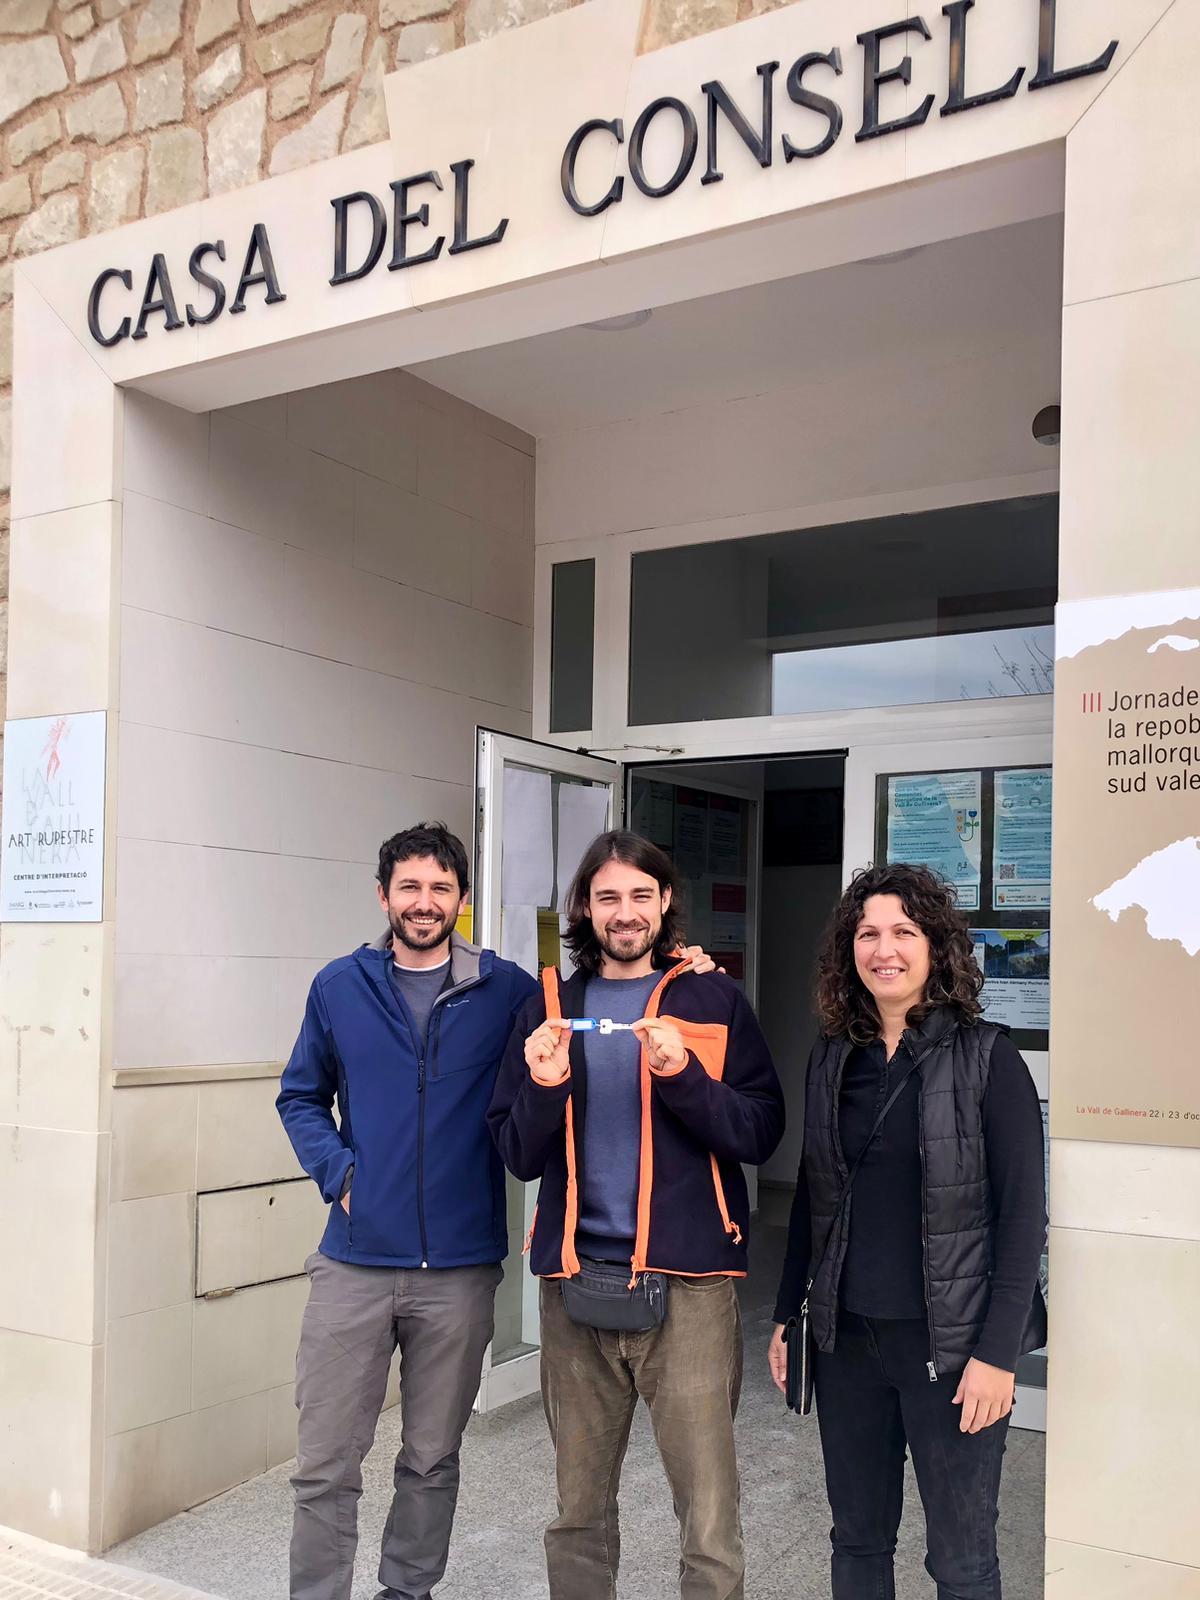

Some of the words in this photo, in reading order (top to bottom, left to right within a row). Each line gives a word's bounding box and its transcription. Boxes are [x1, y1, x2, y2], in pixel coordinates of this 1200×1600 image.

[88, 223, 287, 347] CASA
[328, 159, 509, 287] DEL
[560, 0, 1119, 217] CONSELL
[1082, 692, 1101, 713] III
[1108, 685, 1199, 712] Jornade
[1108, 718, 1125, 739] la
[1136, 713, 1200, 740] repob
[1107, 771, 1146, 793] sud
[1156, 769, 1200, 791] vale
[8, 832, 34, 848] ART
[38, 829, 95, 846] RUPESTRE
[36, 871, 88, 880] D'INTERPRETACIÓ
[1076, 1106, 1086, 1114] La
[1087, 1106, 1100, 1114] Vall
[1102, 1107, 1112, 1115] de
[1114, 1107, 1147, 1117] Gallinera
[1149, 1109, 1160, 1118] 22
[1168, 1110, 1180, 1119] 23
